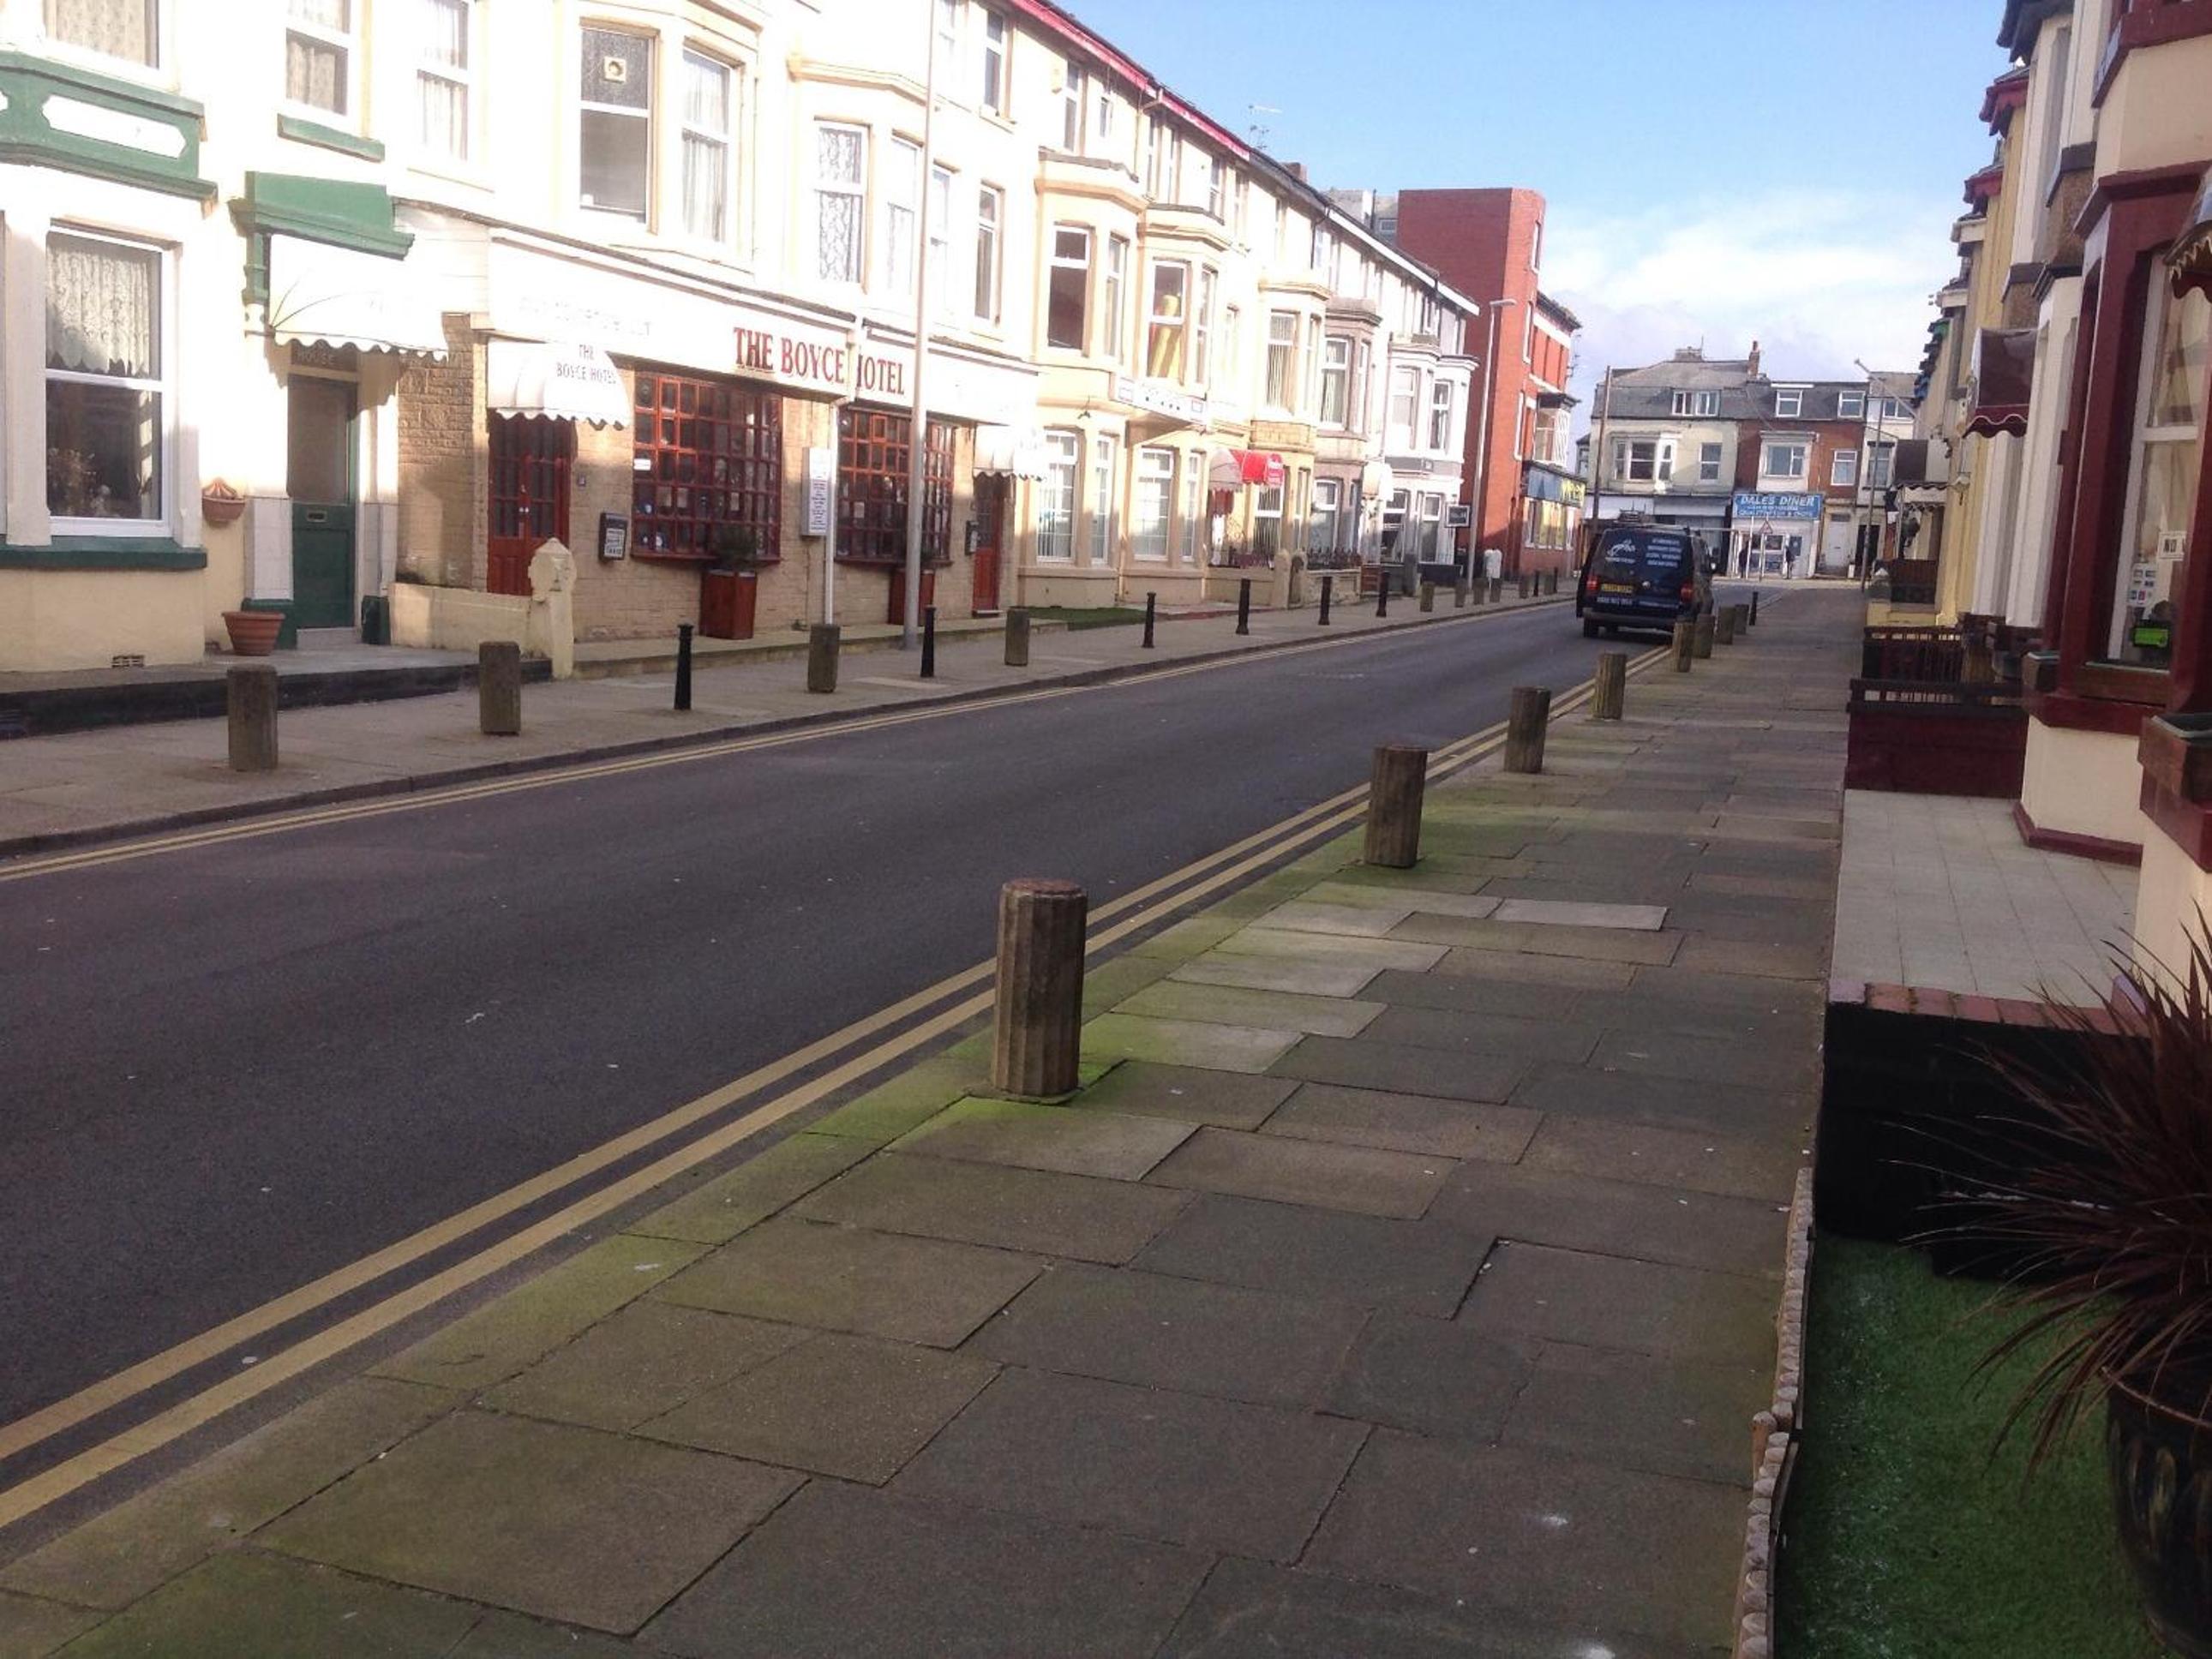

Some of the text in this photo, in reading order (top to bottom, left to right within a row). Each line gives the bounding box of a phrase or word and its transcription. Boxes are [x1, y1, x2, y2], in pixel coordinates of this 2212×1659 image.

[578, 344, 595, 360] THE
[734, 326, 774, 370] THE
[781, 337, 845, 384] BOYCE
[556, 362, 587, 380] BOYCE
[1741, 495, 1814, 506] DALES DINER
